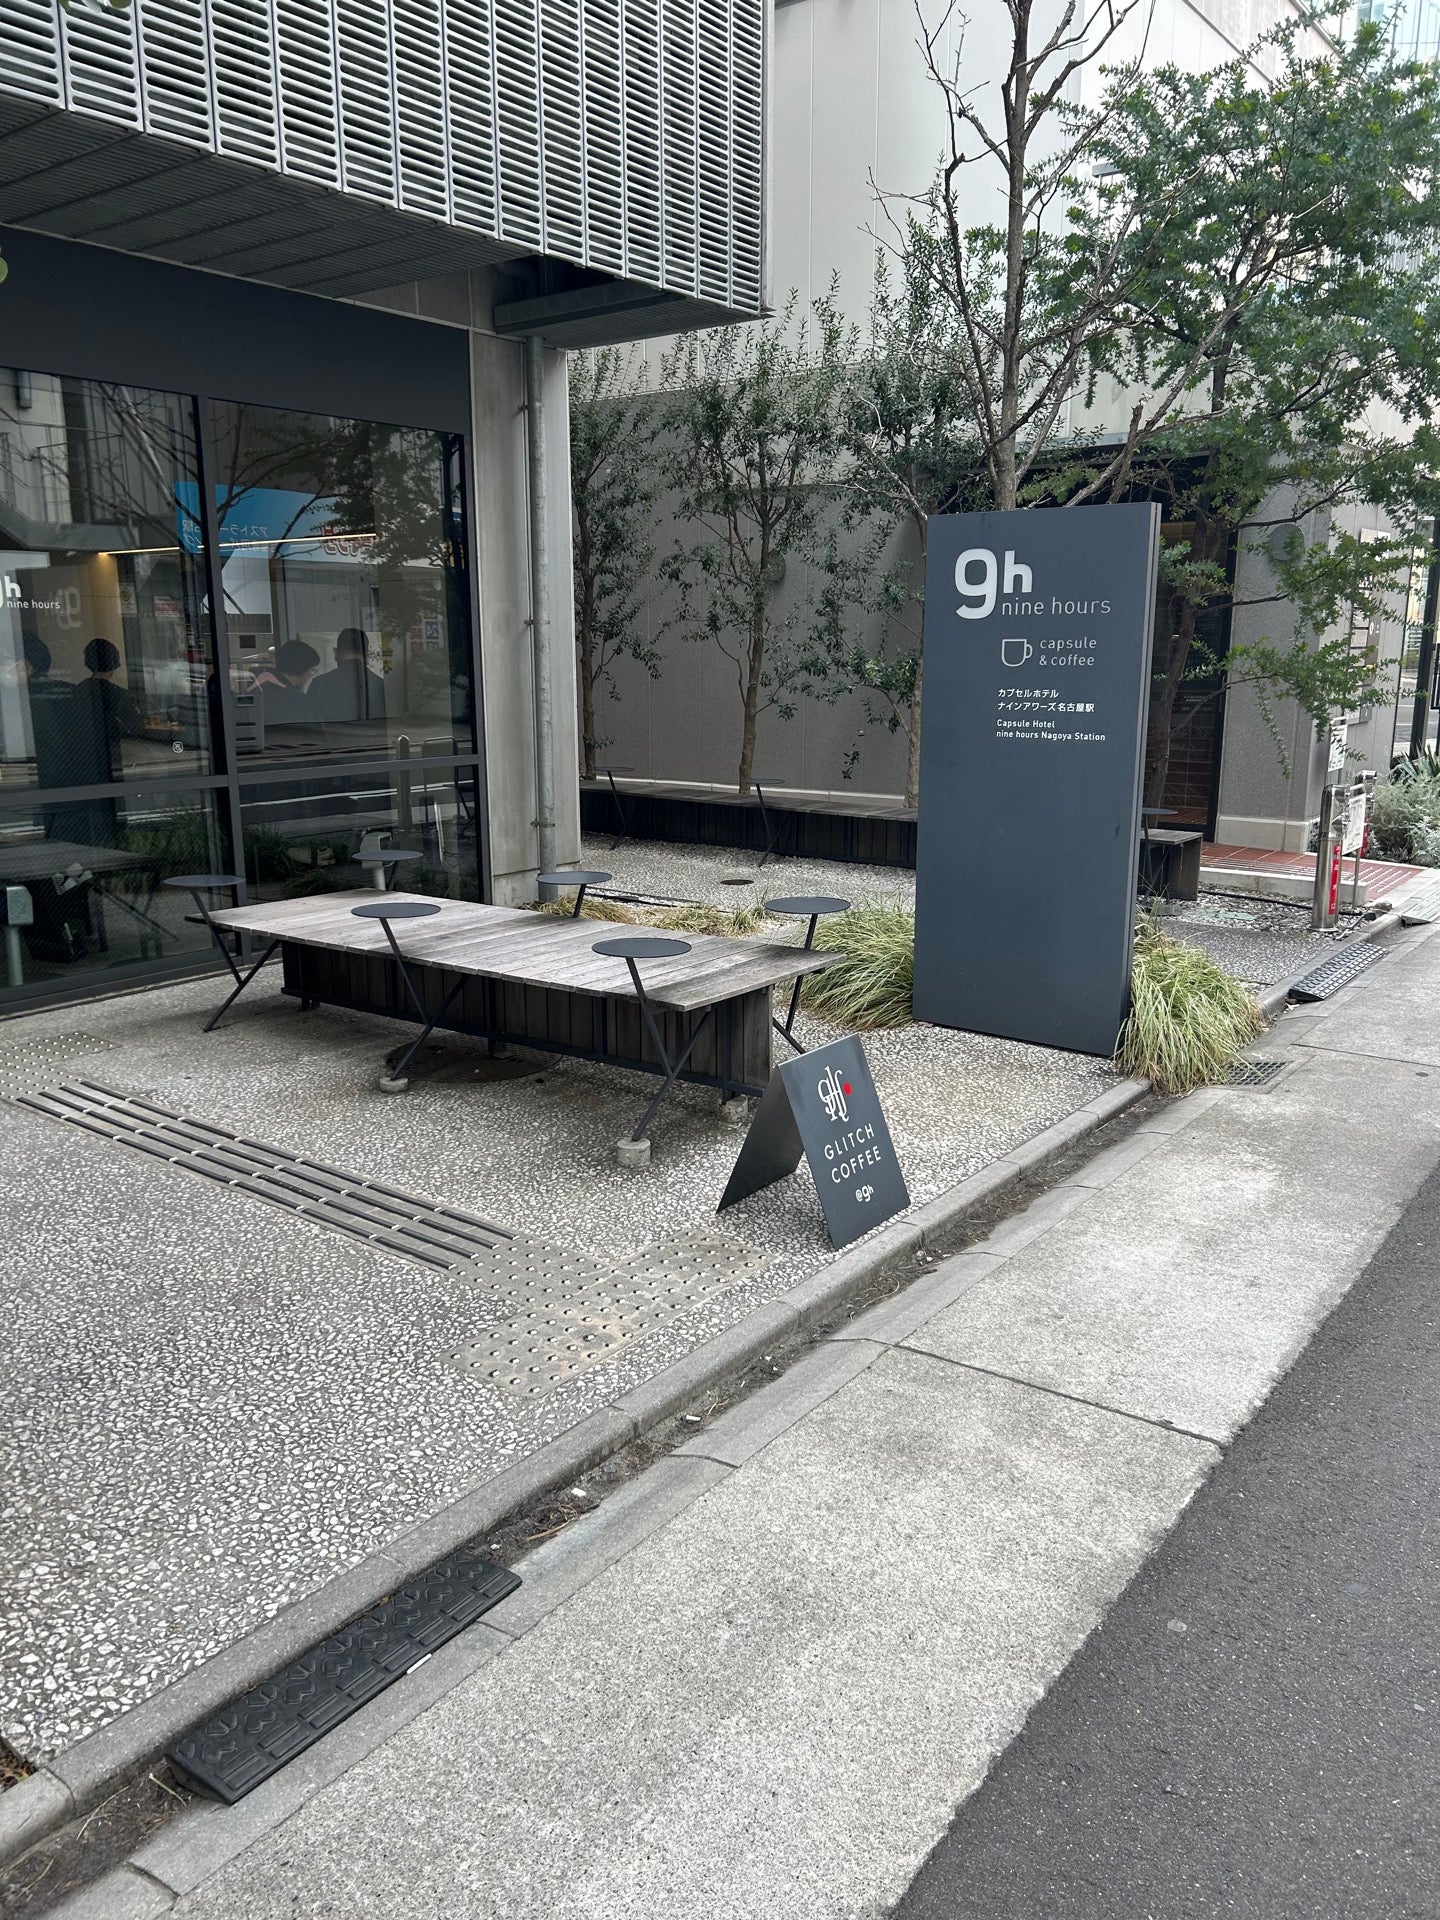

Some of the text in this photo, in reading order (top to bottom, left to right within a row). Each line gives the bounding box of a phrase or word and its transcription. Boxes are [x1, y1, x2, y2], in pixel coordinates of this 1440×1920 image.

[6, 599, 61, 609] nine hours
[1002, 597, 1111, 616] nine hours
[1039, 636, 1097, 656] capsule
[997, 718, 1055, 731] Capsule Hotel
[996, 730, 1106, 742] nine hours Nagoya Station
[824, 1123, 875, 1160] GLITCH
[831, 1145, 882, 1183] COFFEE
